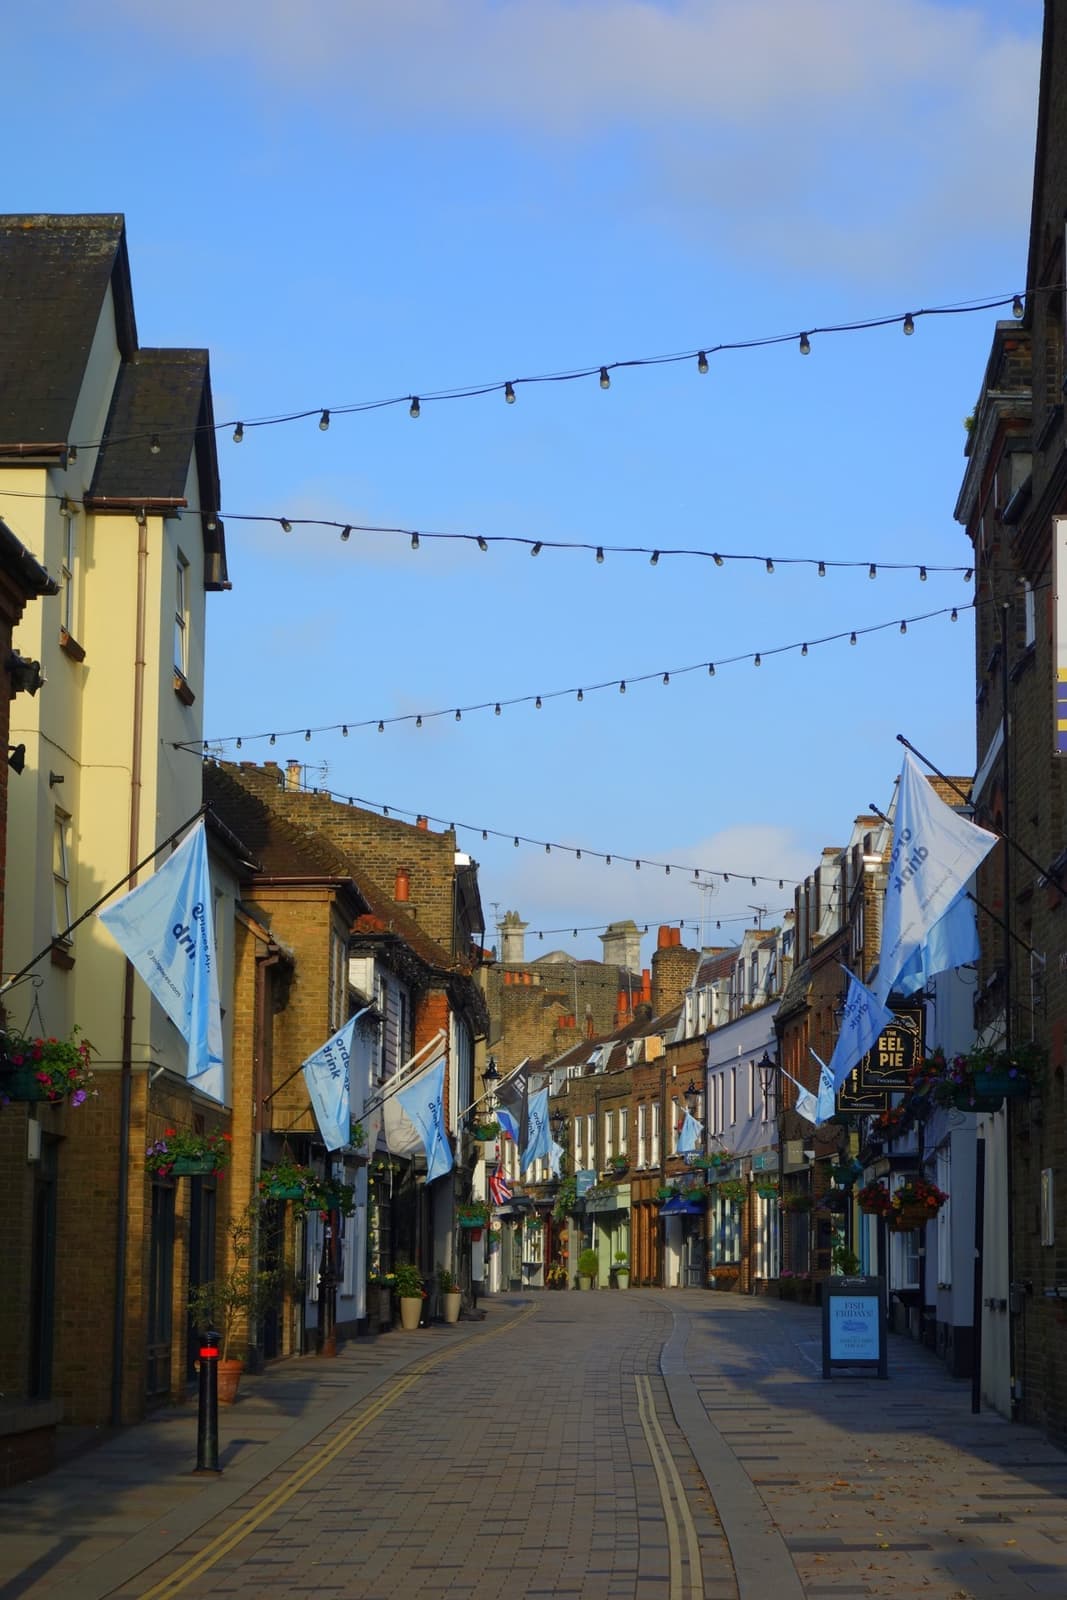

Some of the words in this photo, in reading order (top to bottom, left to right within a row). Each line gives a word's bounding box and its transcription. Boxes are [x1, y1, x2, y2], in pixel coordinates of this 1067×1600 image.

[878, 1037, 905, 1051] EEL
[322, 1045, 341, 1080] drink
[879, 1052, 904, 1067] PIE
